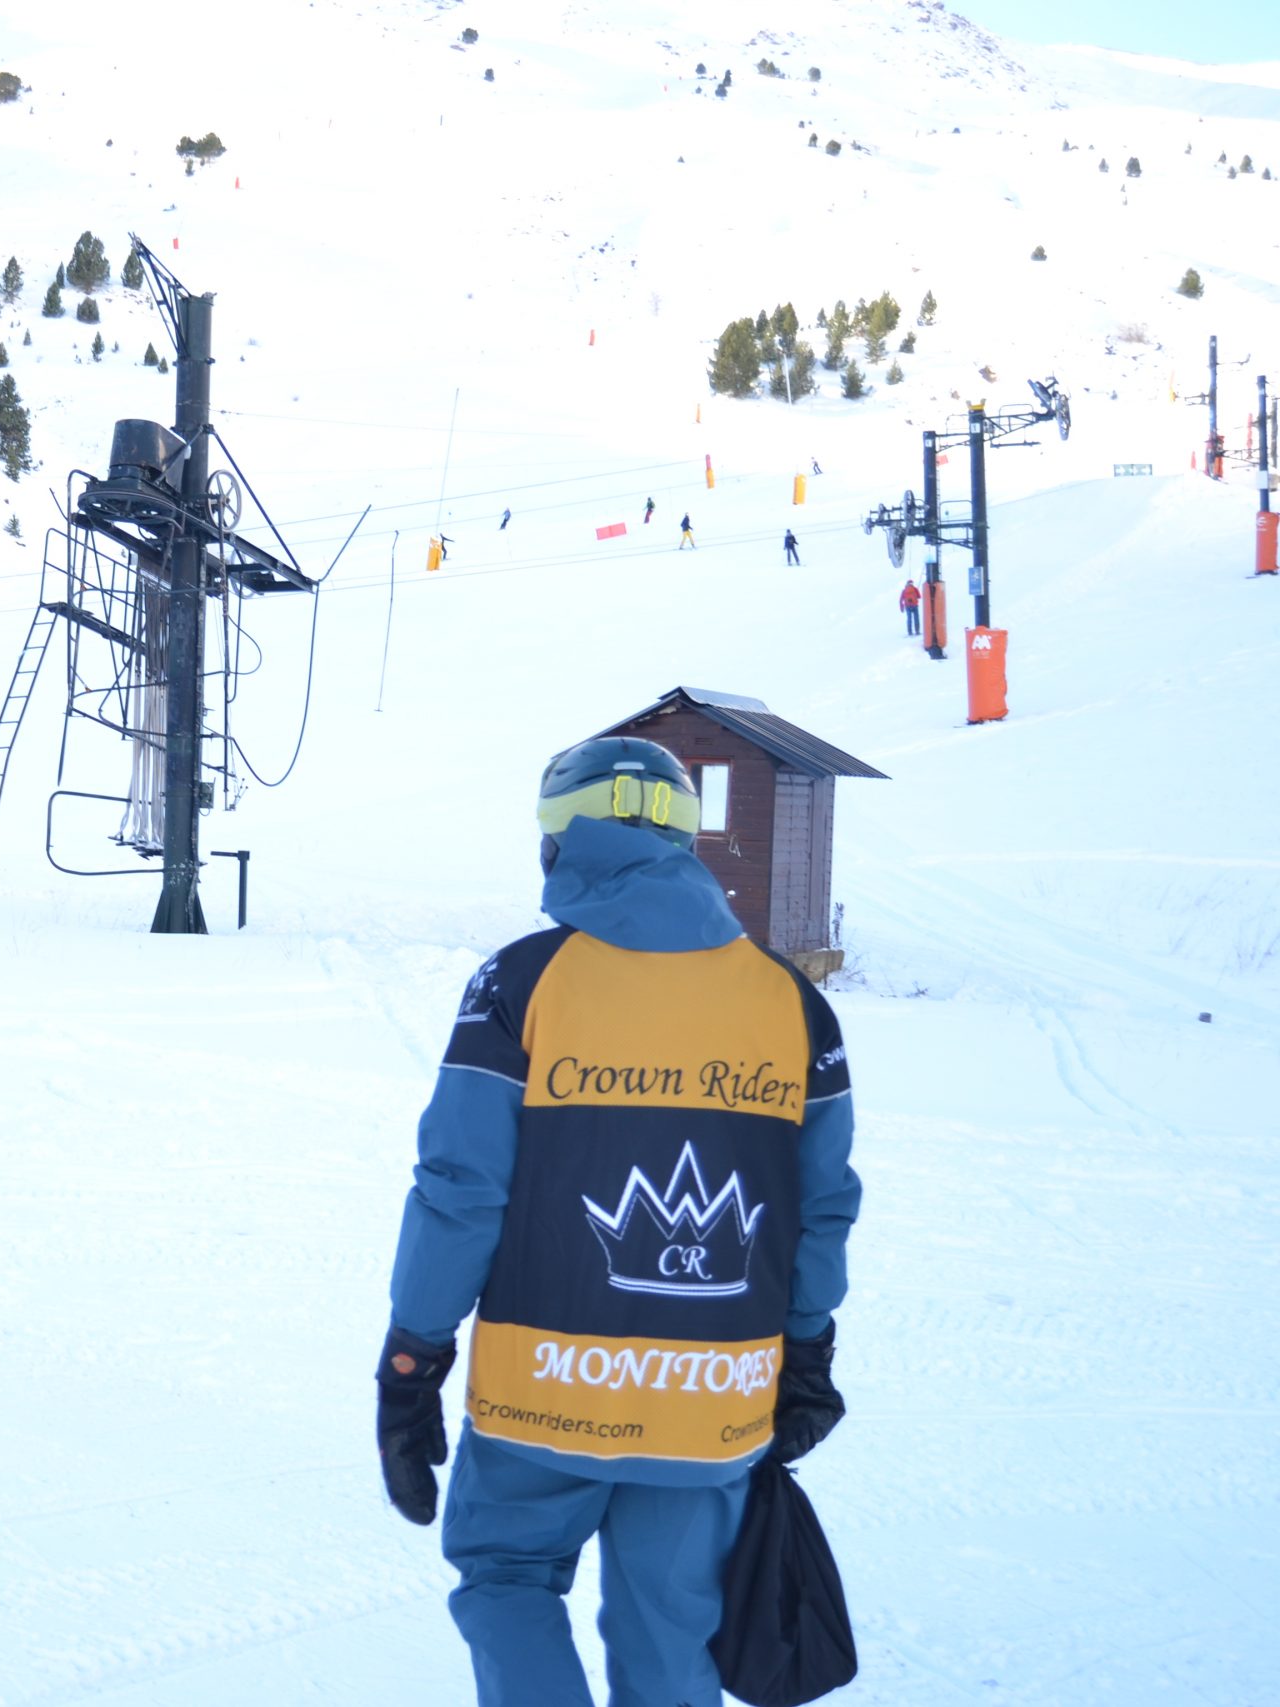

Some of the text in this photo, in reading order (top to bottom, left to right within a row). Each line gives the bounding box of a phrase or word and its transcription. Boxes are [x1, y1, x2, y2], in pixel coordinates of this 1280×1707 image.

[547, 1057, 683, 1099] Crown
[658, 1244, 712, 1280] CR
[533, 1341, 776, 1396] MONITORES
[477, 1399, 643, 1438] Crownriders.com
